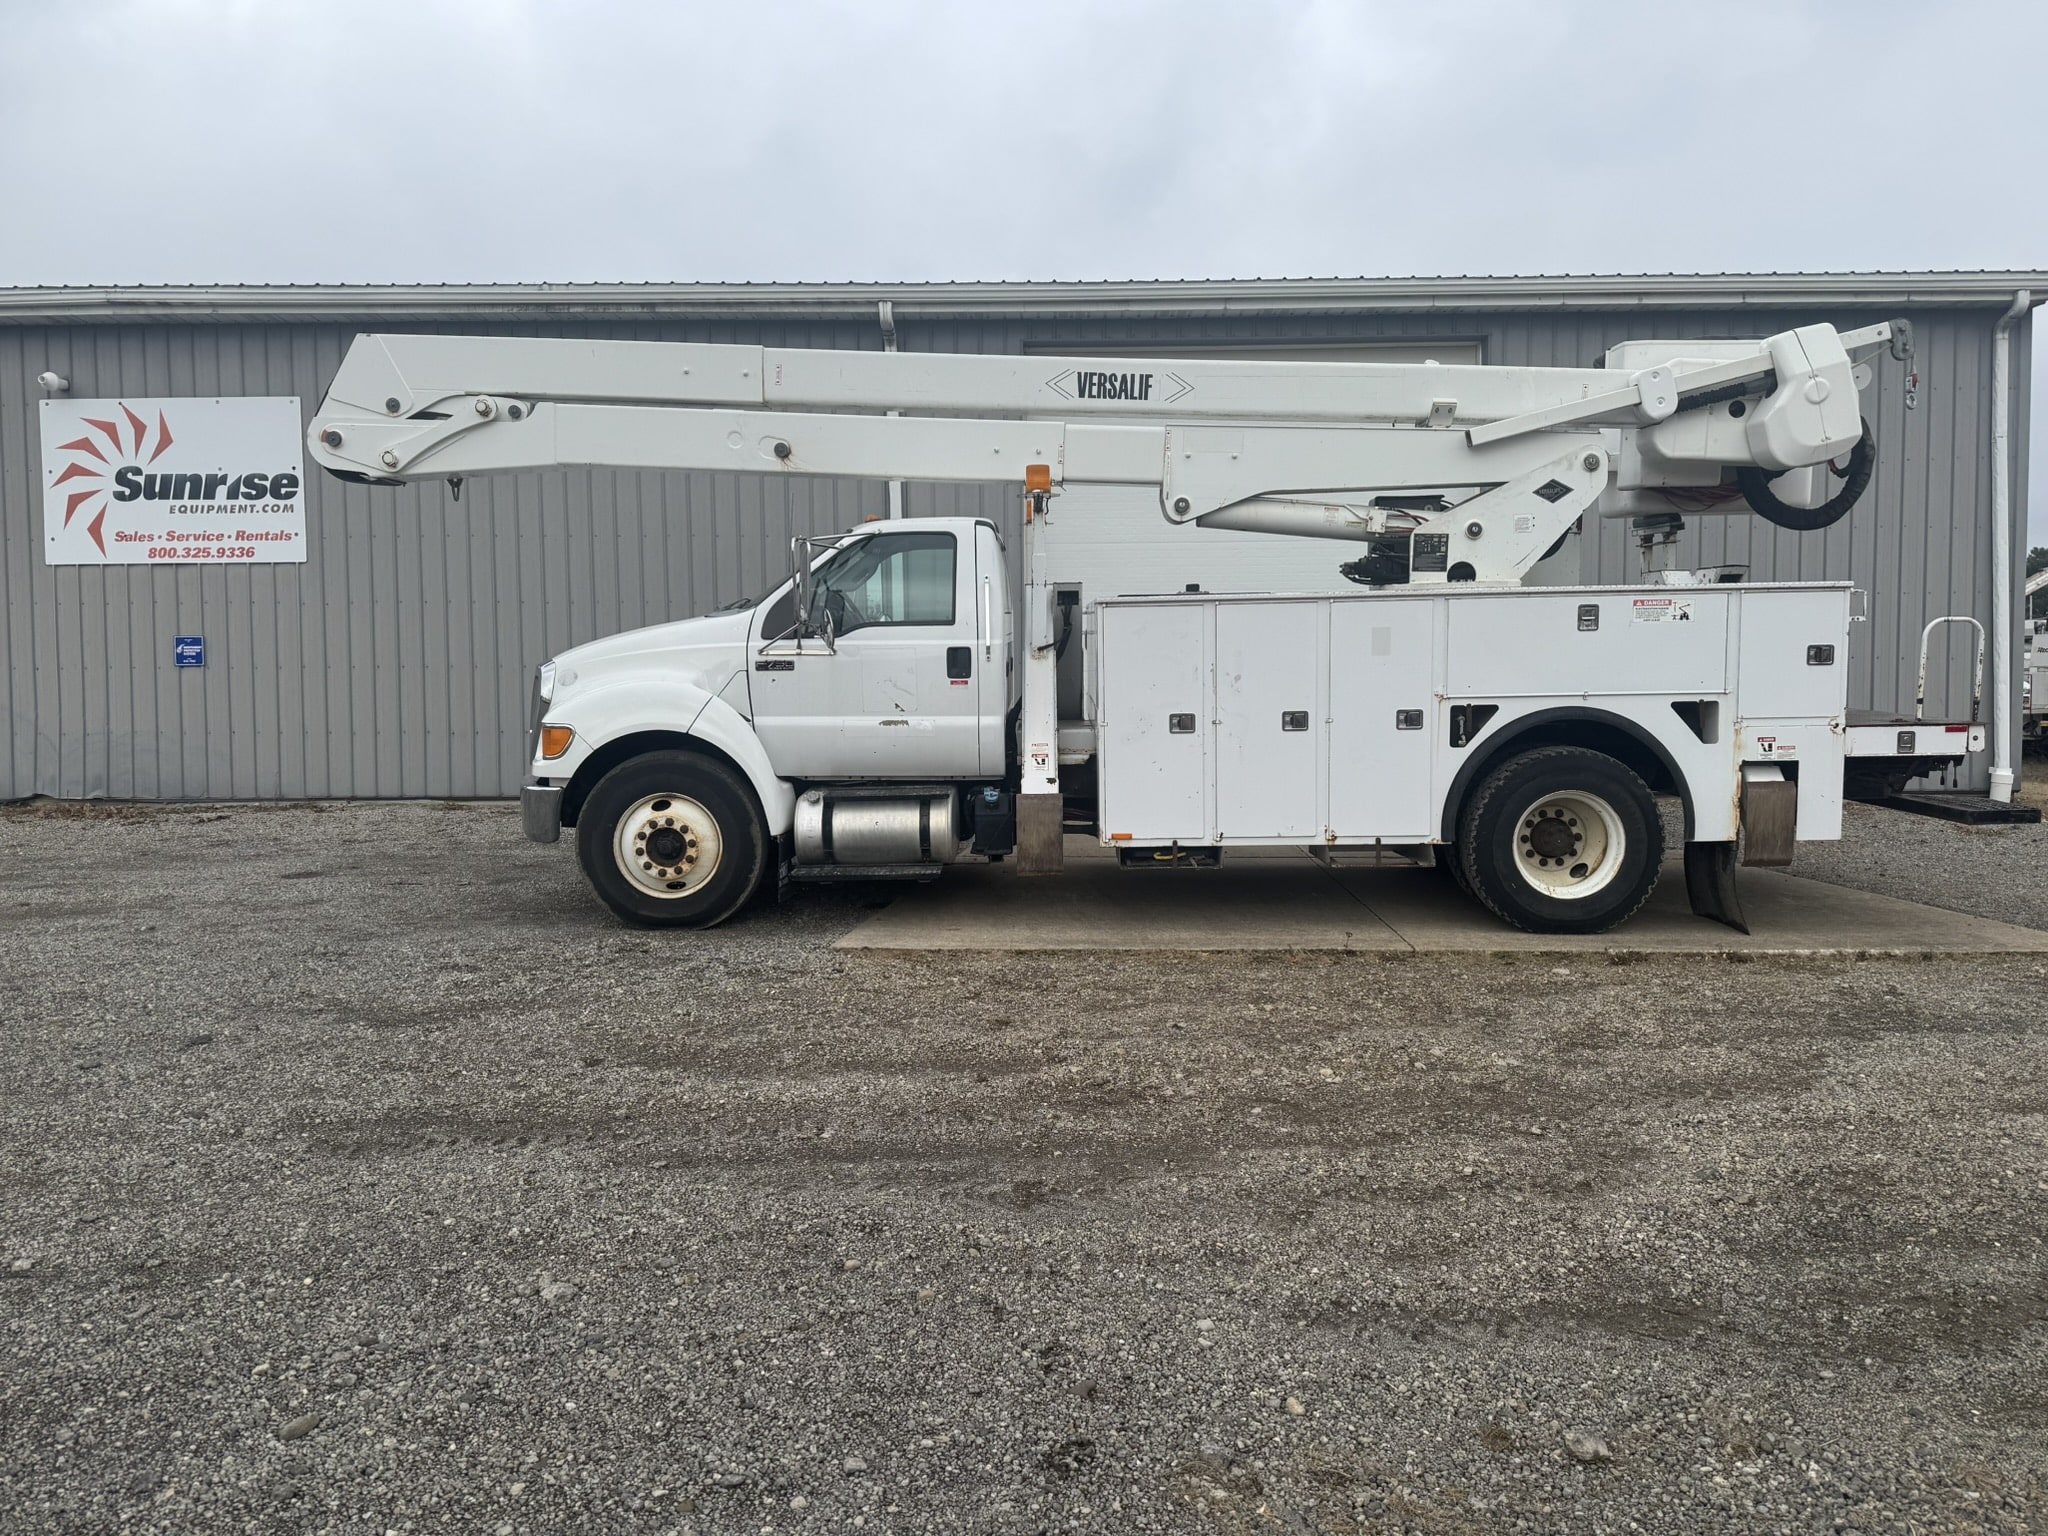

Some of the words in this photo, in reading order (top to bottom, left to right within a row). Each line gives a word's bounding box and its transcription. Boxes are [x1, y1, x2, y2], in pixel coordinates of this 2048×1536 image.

[112, 465, 299, 502] Sunrise
[169, 504, 295, 515] EQUIPMENT.COM
[114, 530, 155, 543] Sales
[165, 530, 225, 542] Service
[235, 530, 293, 542] Rentals
[148, 547, 255, 559] 800.325.9336
